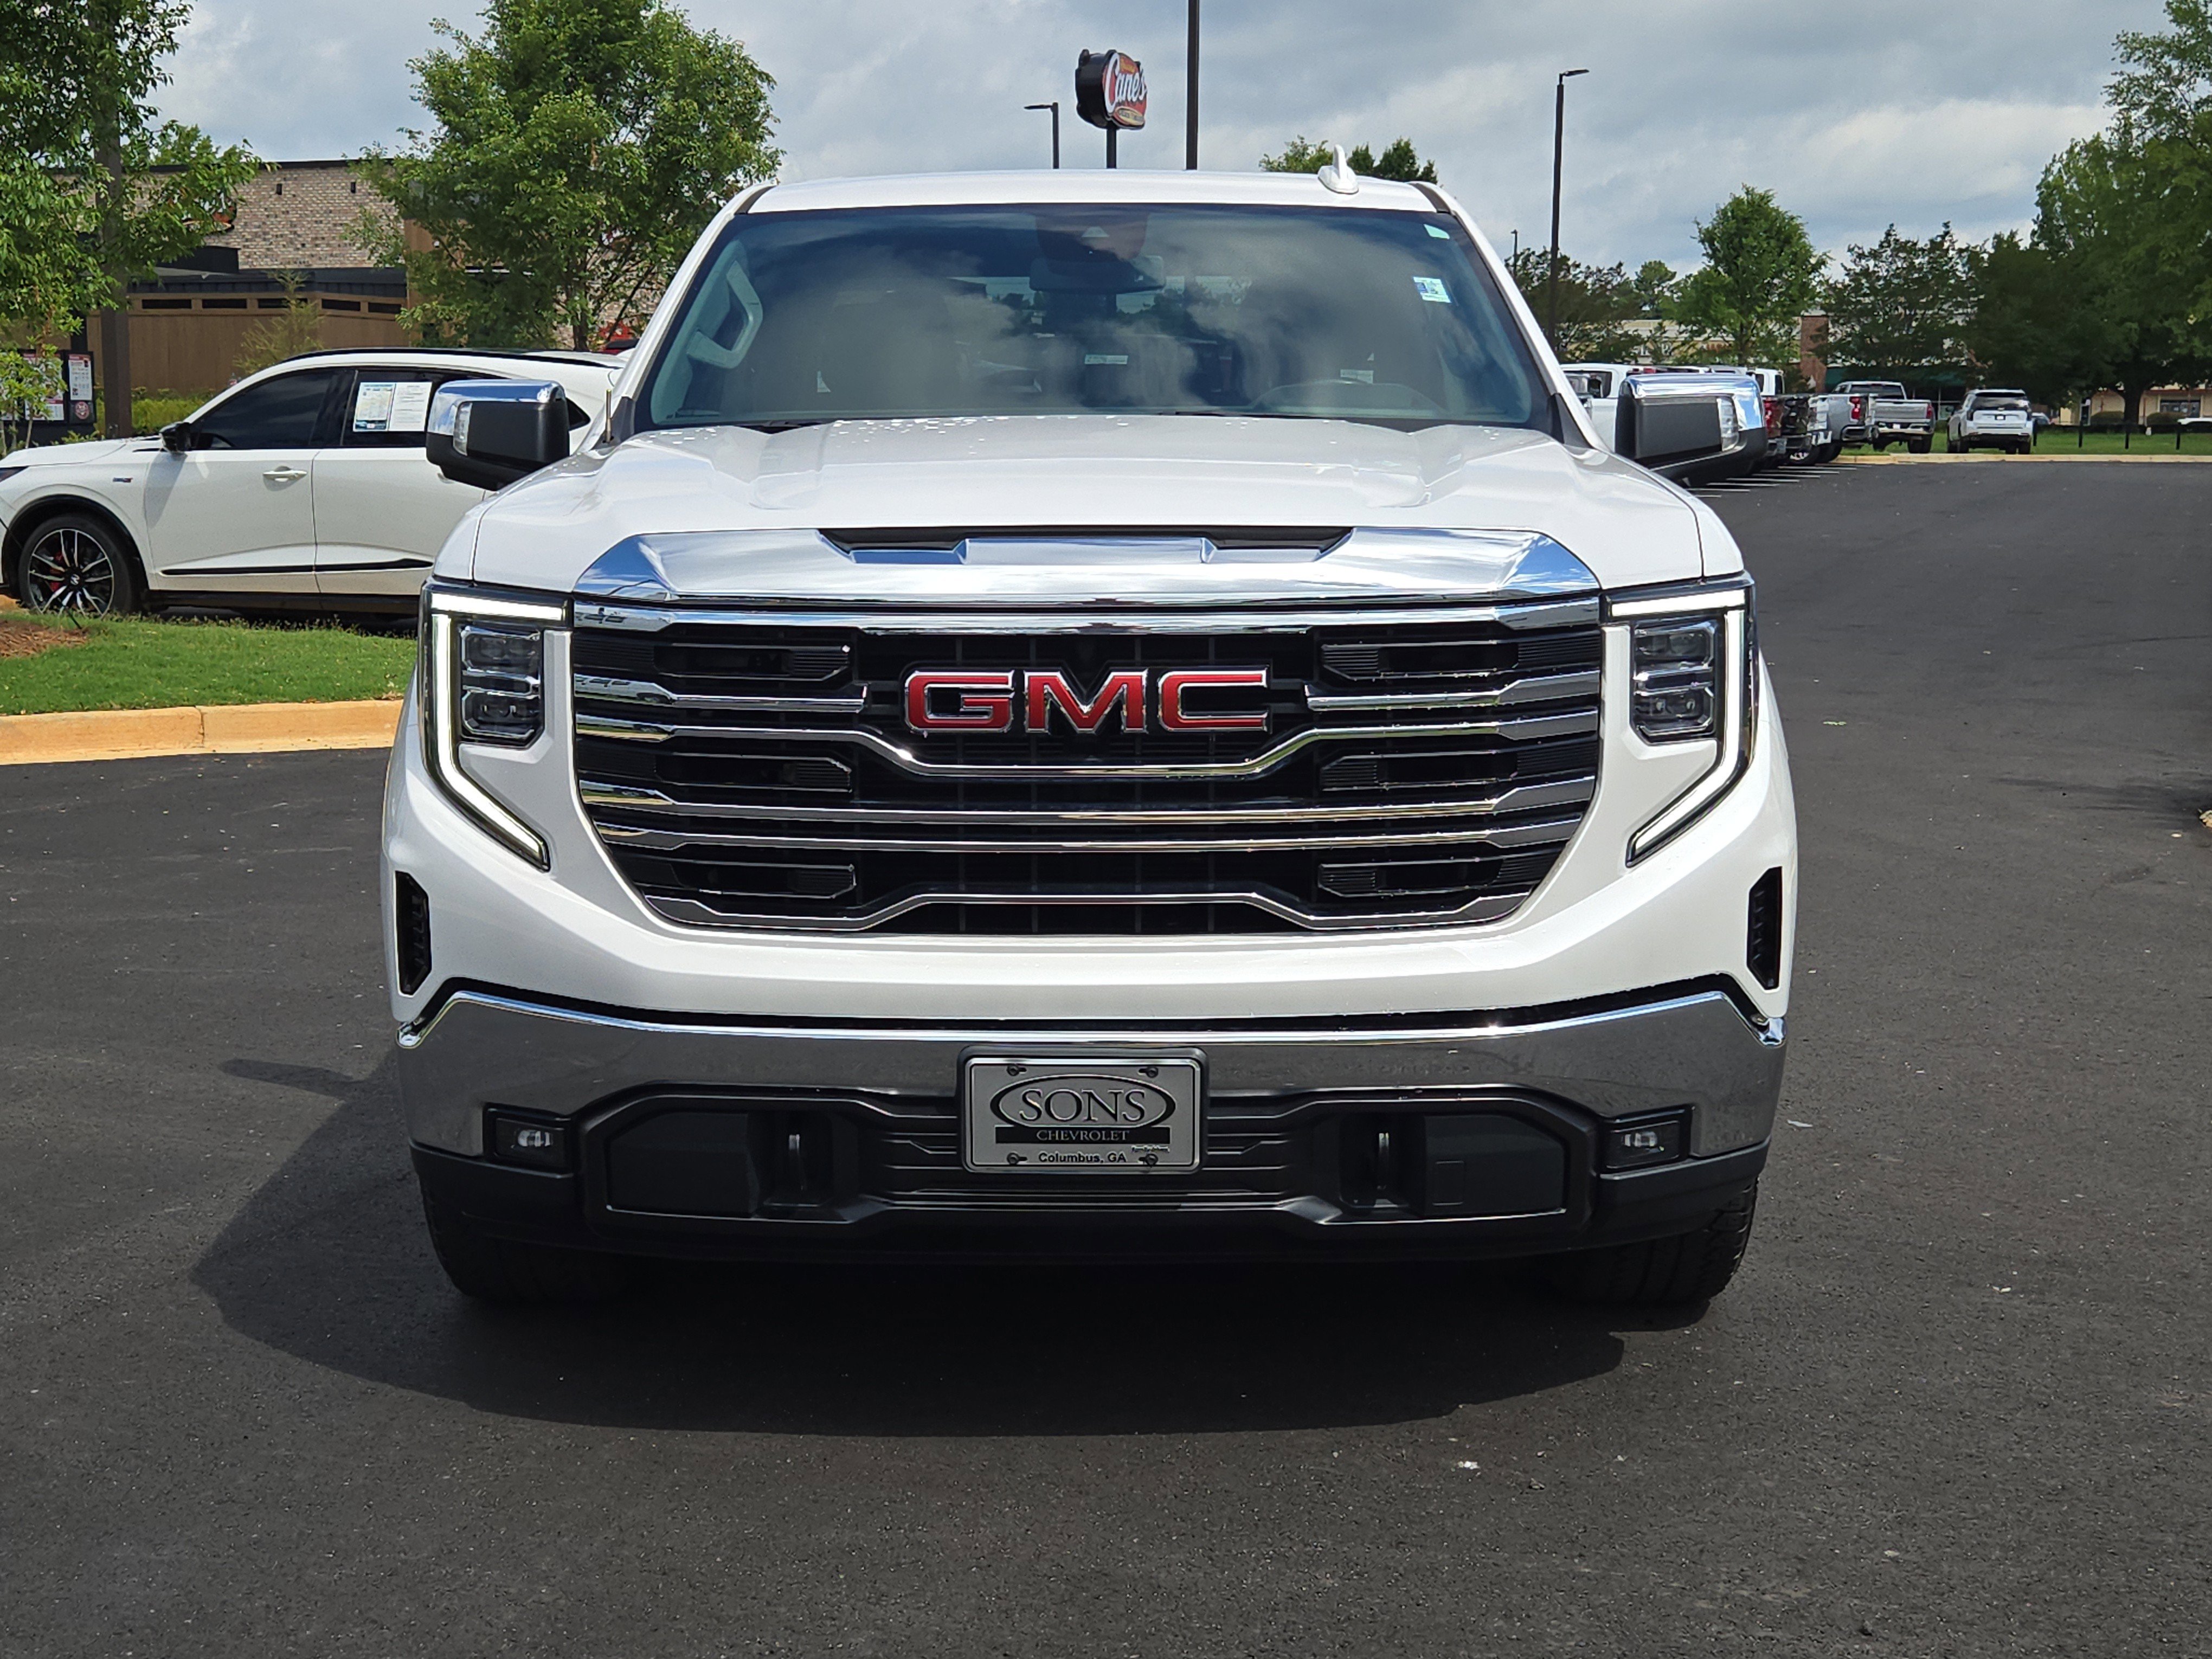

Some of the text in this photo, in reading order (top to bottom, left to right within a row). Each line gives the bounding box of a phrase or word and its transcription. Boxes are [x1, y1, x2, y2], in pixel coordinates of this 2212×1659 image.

[904, 669, 1268, 734] GMC
[1019, 1089, 1145, 1122] SONS
[1037, 1130, 1129, 1141] CHEVROLET
[1038, 1152, 1126, 1163] Columbus, GA
